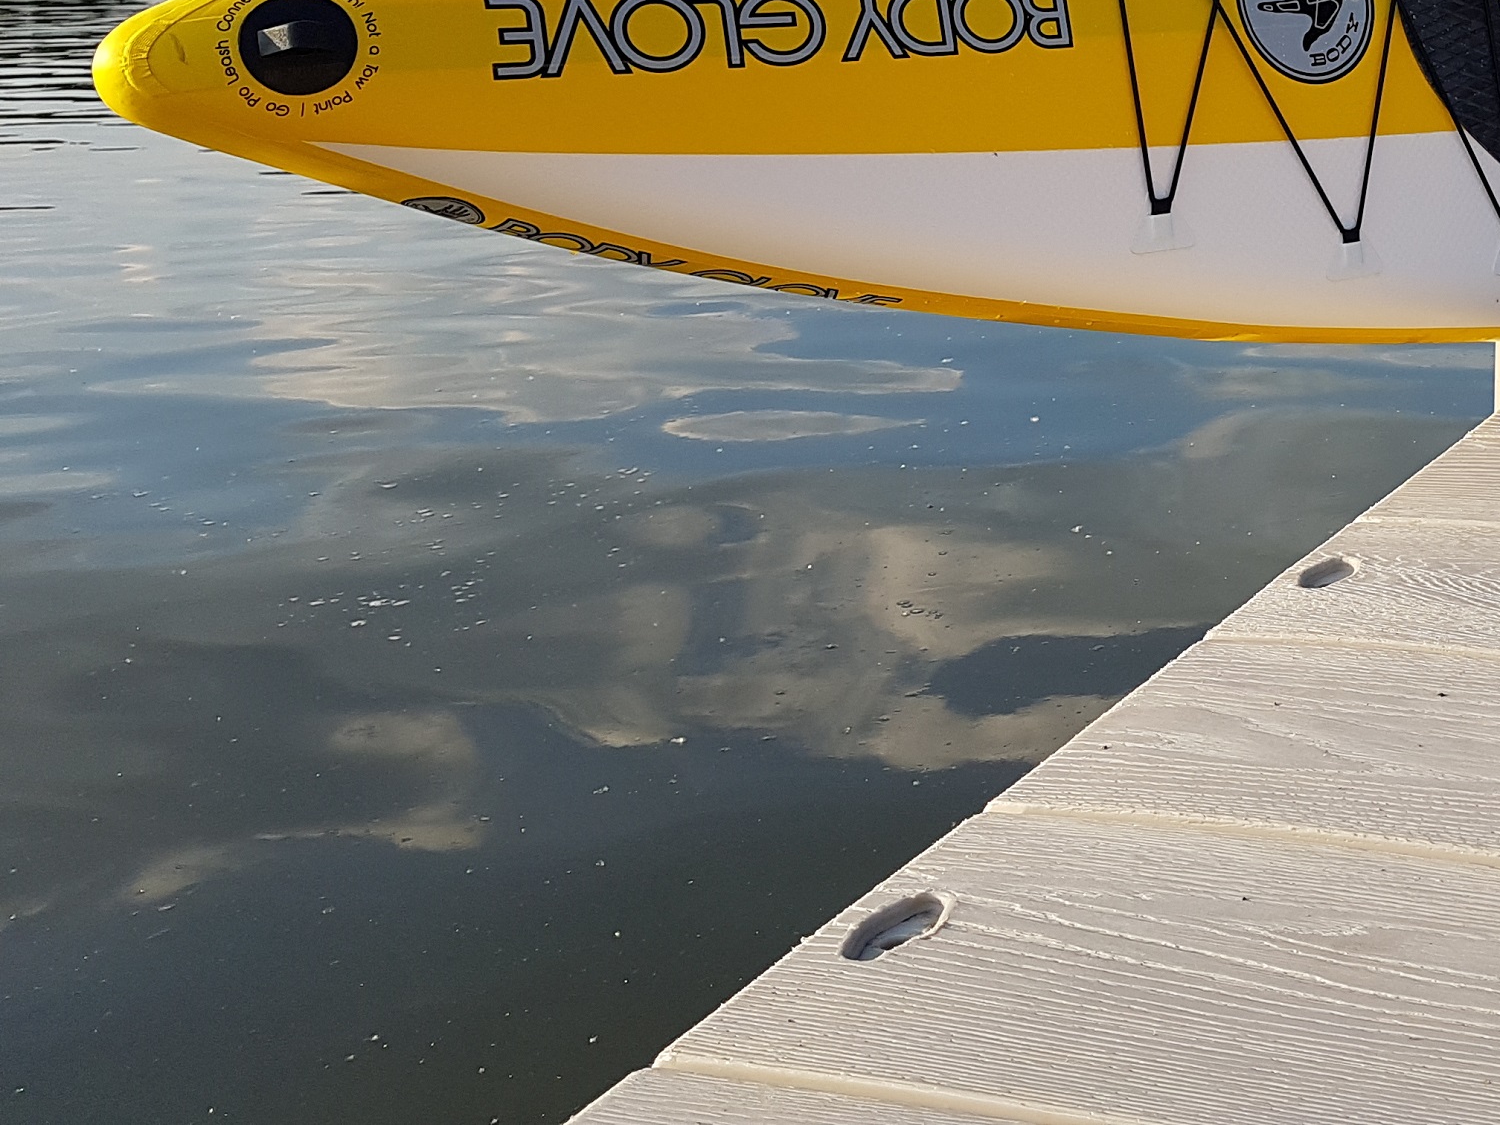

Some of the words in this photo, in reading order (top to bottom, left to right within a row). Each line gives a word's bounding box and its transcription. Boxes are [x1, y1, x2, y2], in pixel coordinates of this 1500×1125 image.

[361, 11, 382, 38] Not
[368, 45, 380, 56] a
[1309, 12, 1360, 67] BODY
[215, 39, 239, 86] Leash
[355, 64, 379, 90] Tow
[238, 86, 262, 108] Pro
[265, 102, 290, 117] Go
[313, 90, 354, 116] Point
